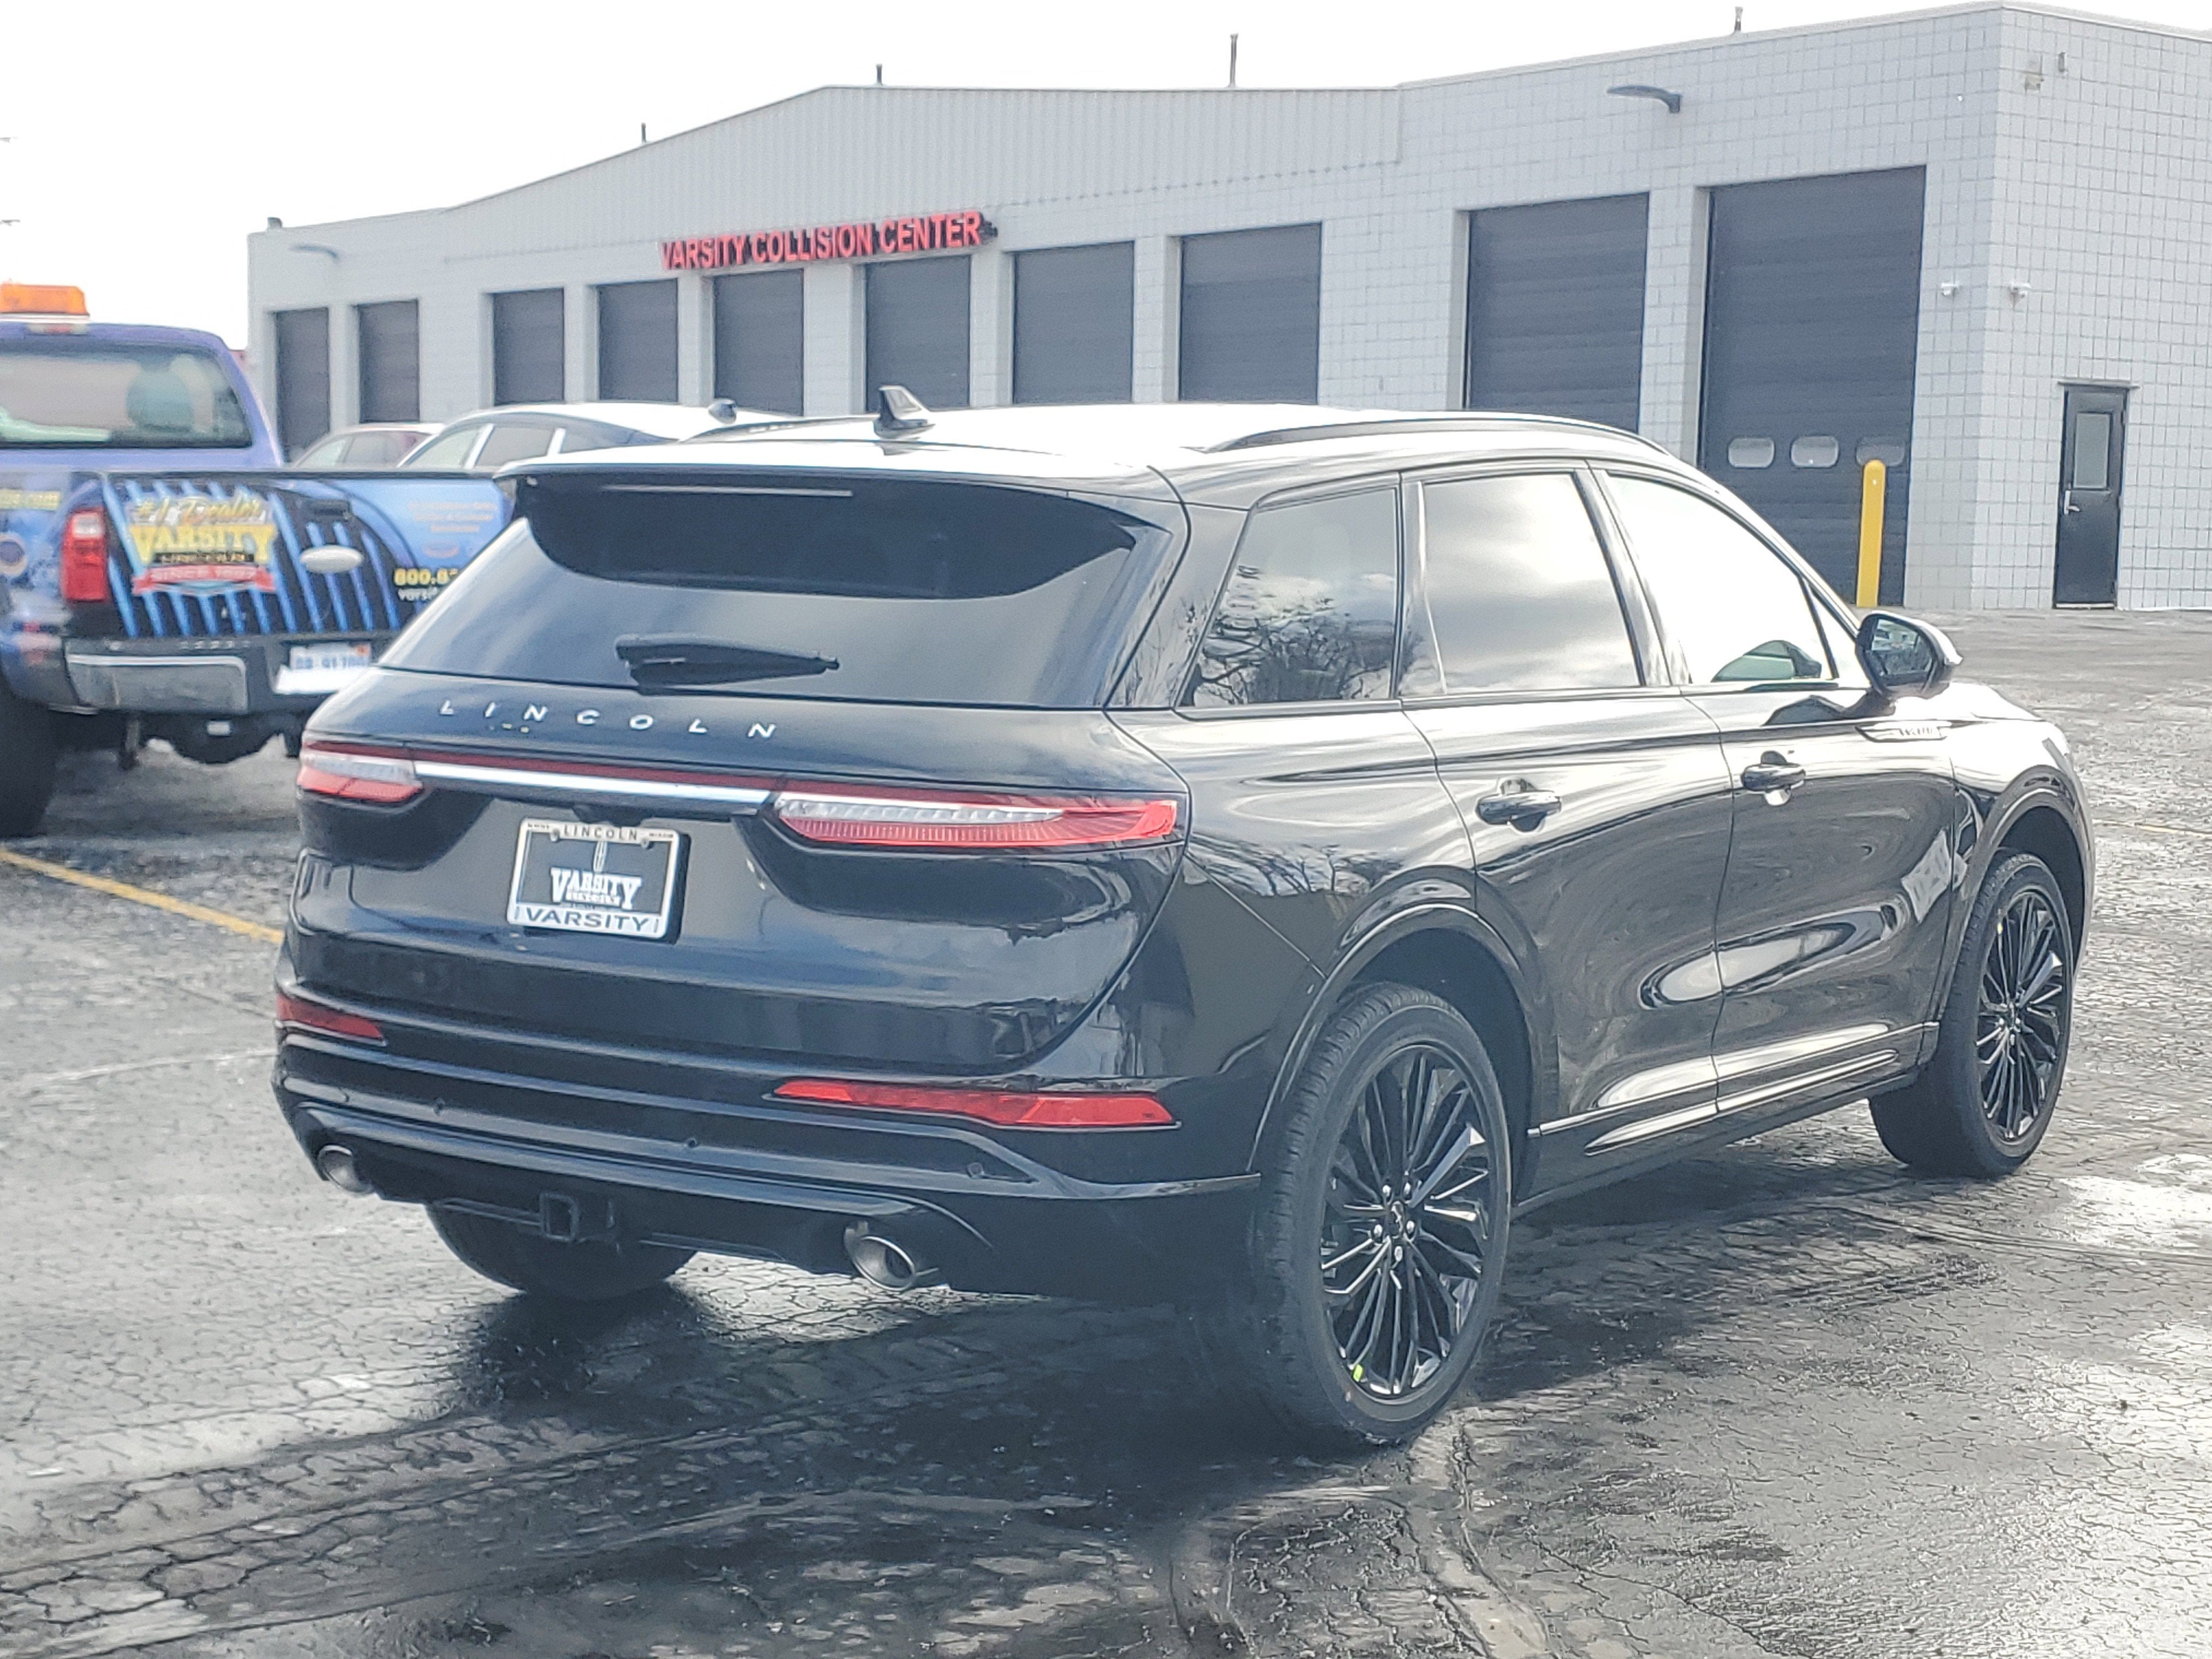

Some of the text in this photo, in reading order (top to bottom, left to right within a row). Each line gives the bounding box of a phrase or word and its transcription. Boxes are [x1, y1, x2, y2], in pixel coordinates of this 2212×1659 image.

[661, 210, 982, 270] VARSITY COLLISION CENTER
[129, 523, 276, 565] VARSITY
[439, 700, 777, 739] LINCOLN
[563, 825, 638, 841] LINCOLN
[550, 866, 642, 911] VARSITY
[525, 906, 649, 933] VARSITY
